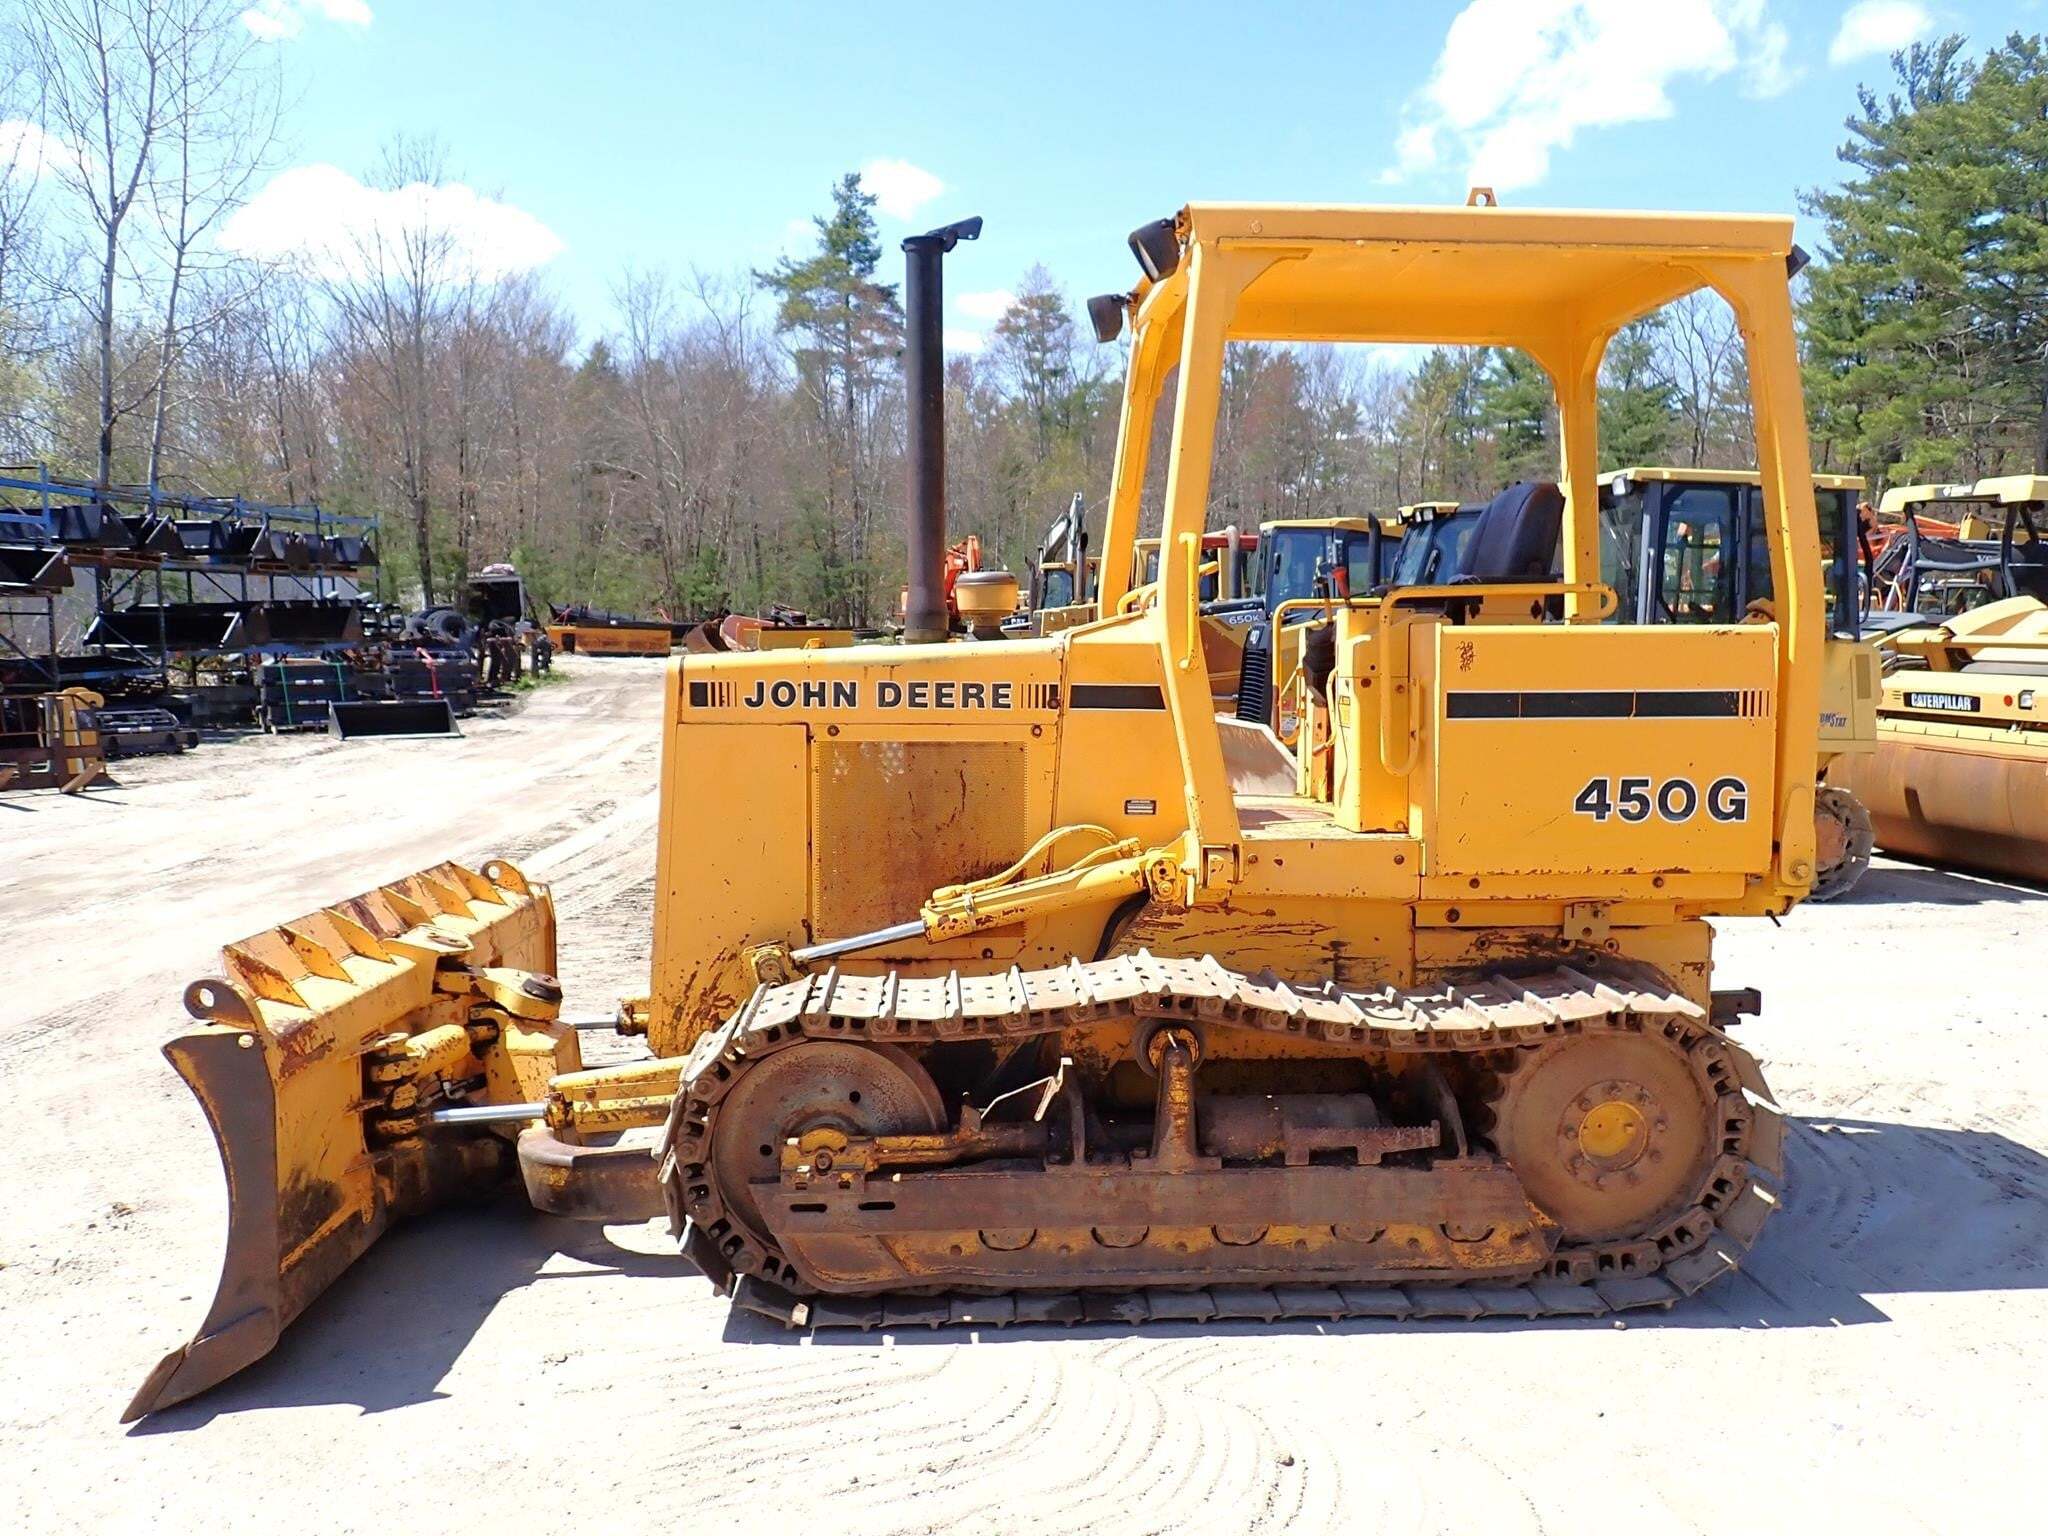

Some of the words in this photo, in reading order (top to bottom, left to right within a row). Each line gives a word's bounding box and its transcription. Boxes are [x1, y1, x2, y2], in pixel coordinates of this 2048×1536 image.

[1229, 614, 1259, 625] 650K
[743, 680, 858, 709] JOHN
[876, 681, 1013, 710] DEERE
[1911, 693, 1973, 711] CATERPILLAR
